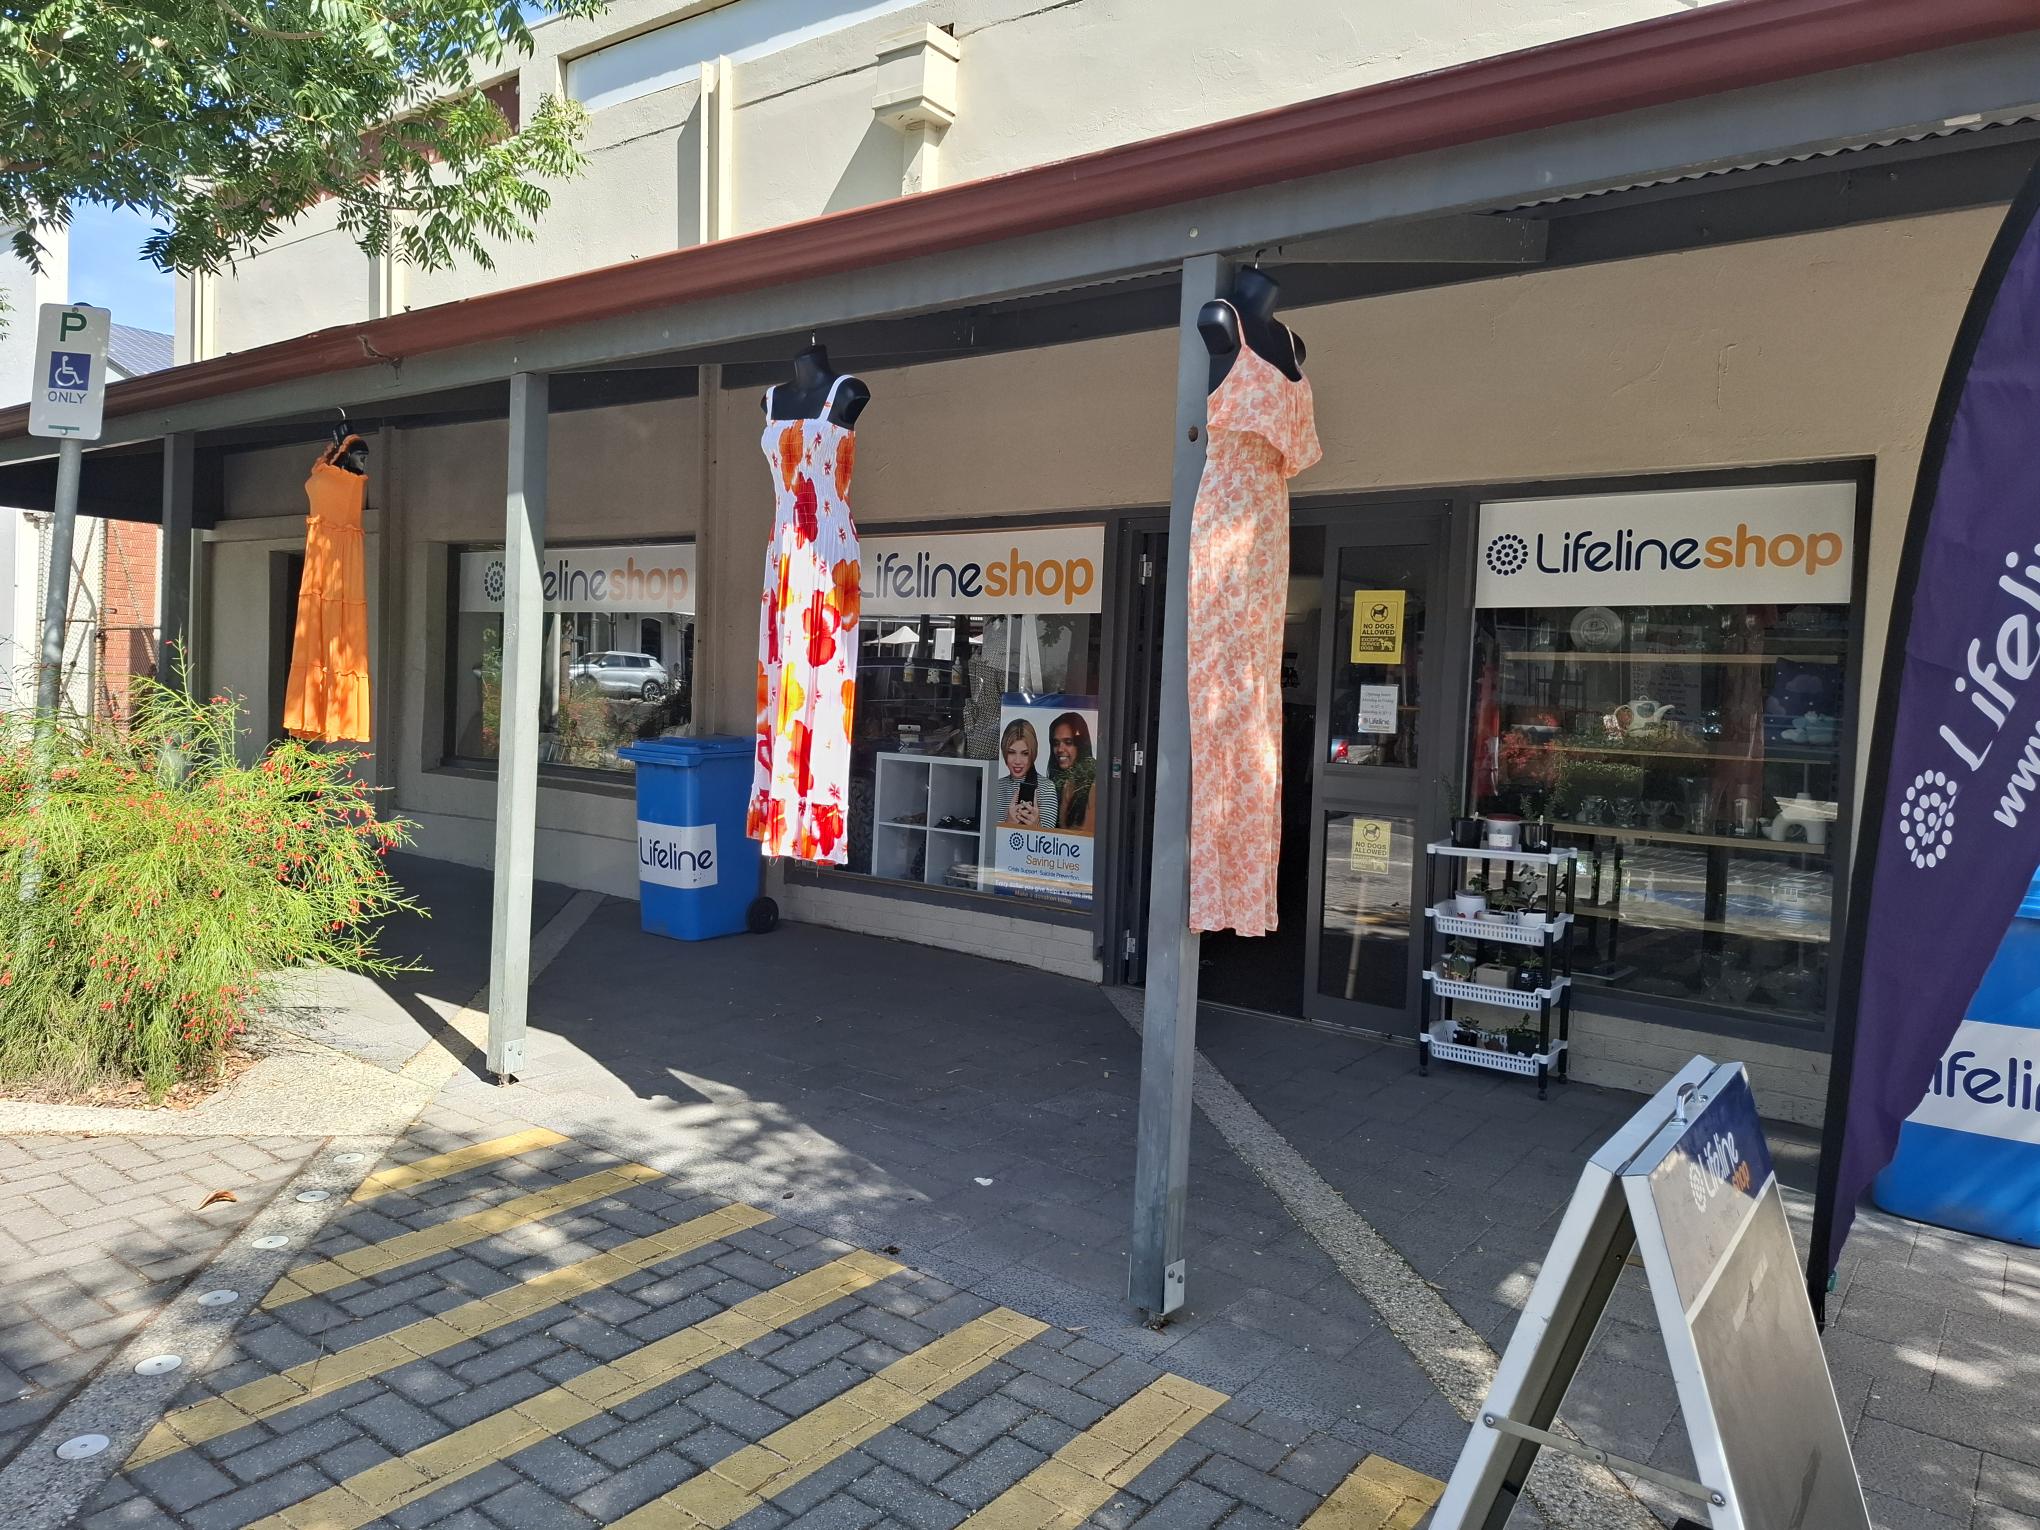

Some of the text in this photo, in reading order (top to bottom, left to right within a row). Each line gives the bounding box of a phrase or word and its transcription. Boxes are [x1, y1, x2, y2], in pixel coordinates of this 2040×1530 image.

[60, 312, 88, 342] P
[47, 391, 87, 404] ONLY
[1939, 543, 2040, 771] Lifeli
[639, 836, 713, 871] Lifeline
[1026, 833, 1081, 858] Lifeline
[1026, 854, 1080, 872] Saving Lives
[1924, 1051, 2040, 1113] ifeli
[1697, 1131, 1739, 1198] Lifeline
